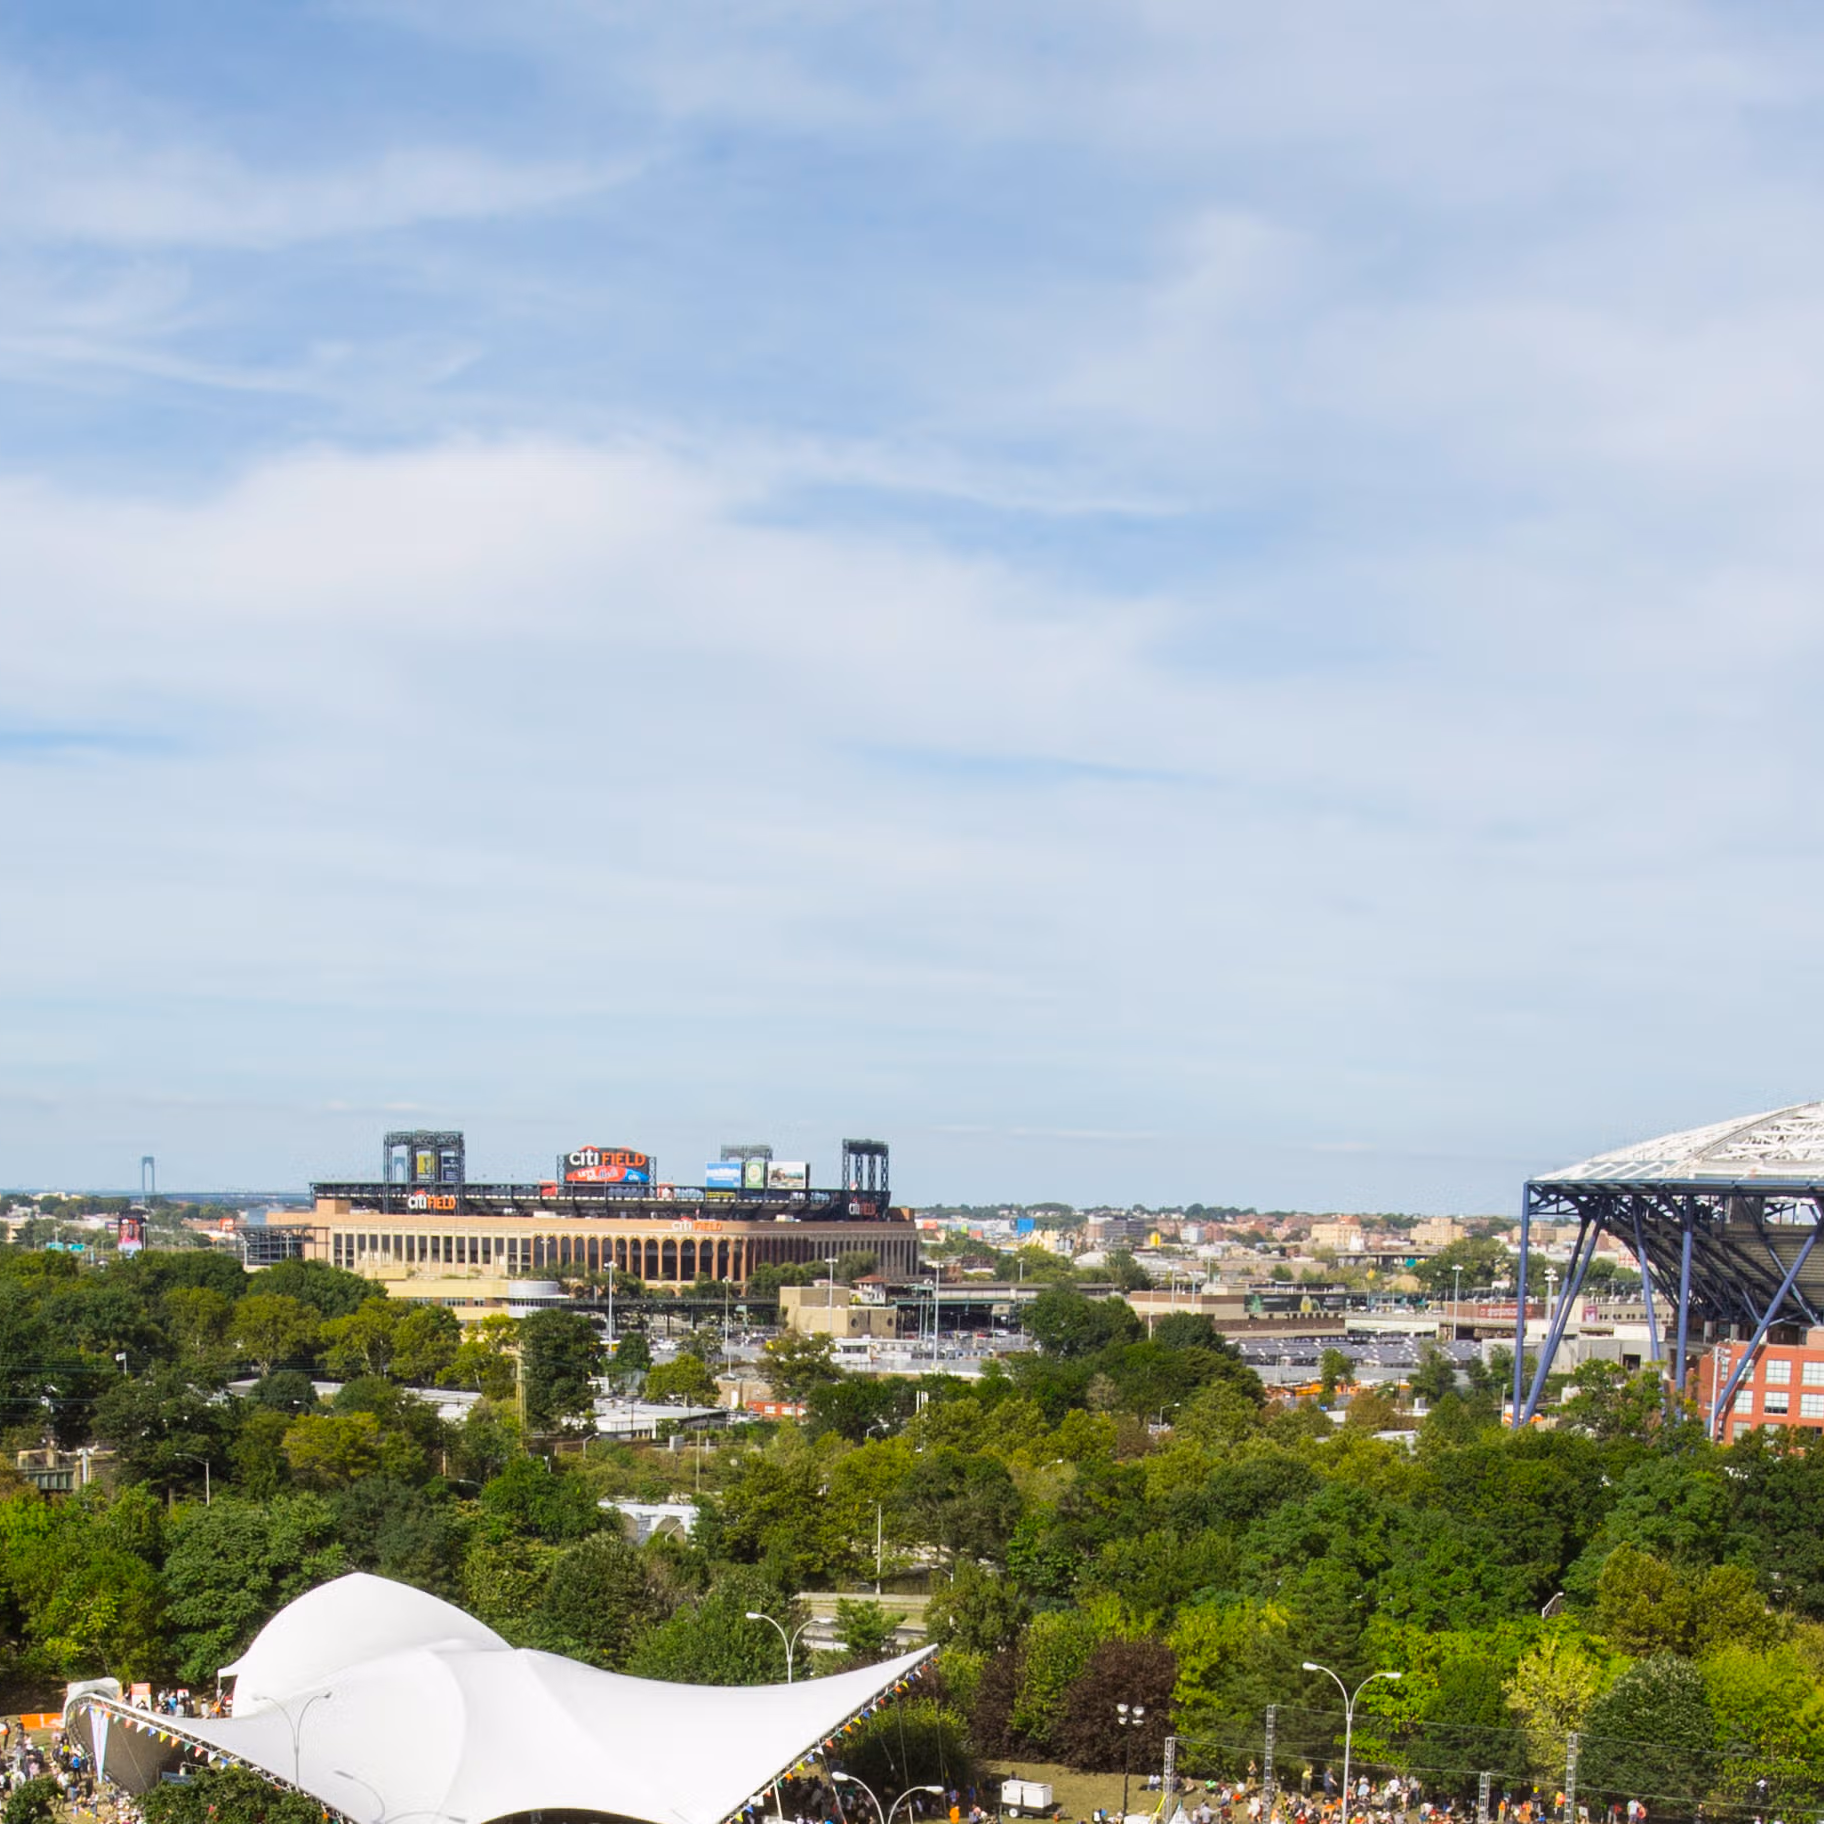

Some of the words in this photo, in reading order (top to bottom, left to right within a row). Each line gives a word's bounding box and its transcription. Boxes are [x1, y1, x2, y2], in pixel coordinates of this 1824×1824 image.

[601, 1151, 647, 1167] FIELD
[427, 1196, 457, 1210] FIELD
[693, 1220, 723, 1232] FIELD
